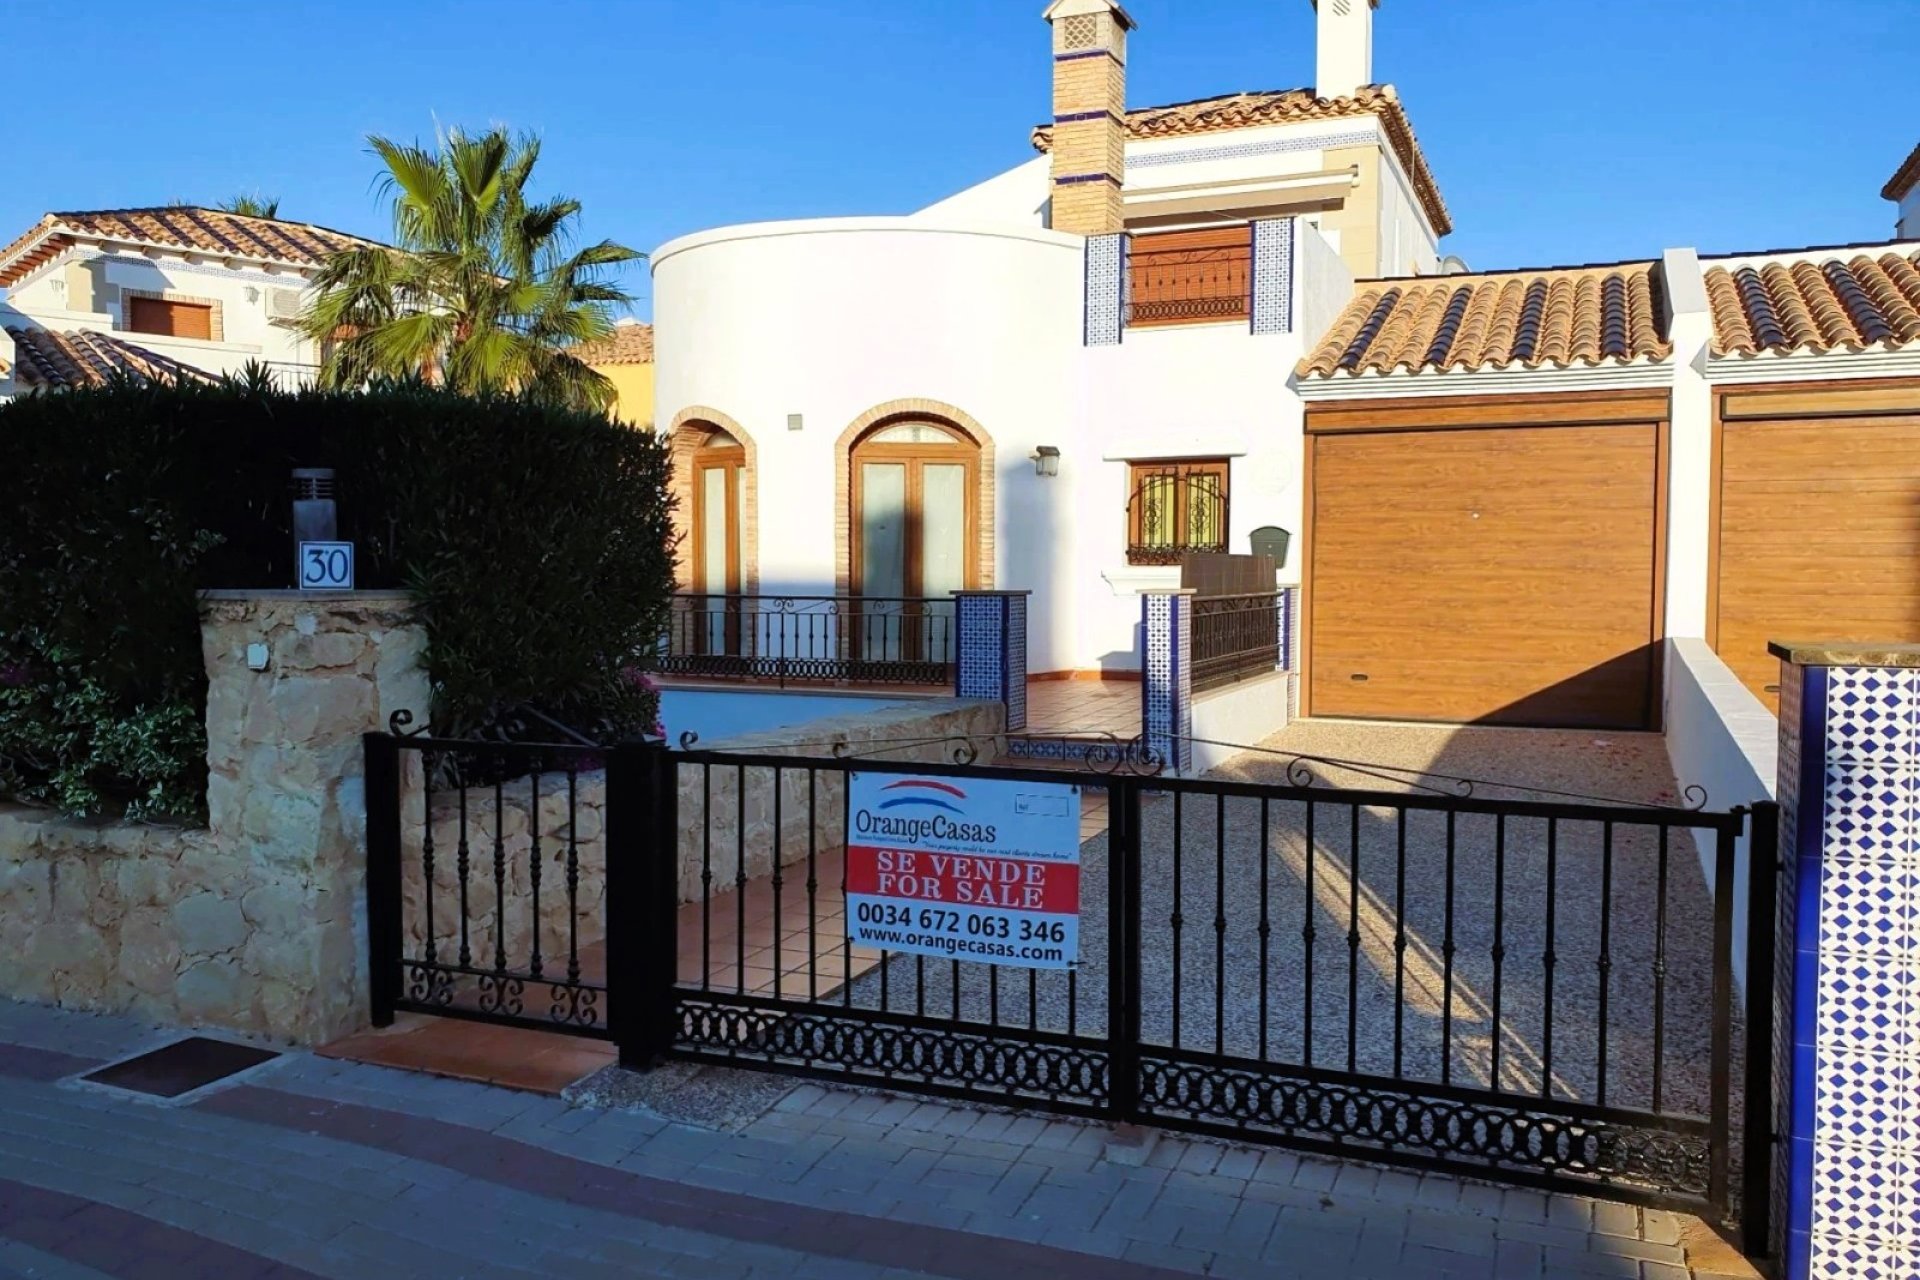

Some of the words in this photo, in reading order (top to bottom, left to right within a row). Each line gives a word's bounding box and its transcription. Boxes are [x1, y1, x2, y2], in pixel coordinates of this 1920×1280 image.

[305, 549, 349, 584] 30
[856, 809, 997, 843] OrangeCasas
[877, 850, 916, 873] SE
[929, 854, 1046, 886] VENDE
[877, 873, 943, 899] FOR
[956, 880, 1044, 909] SALE
[858, 902, 912, 927] 0034
[919, 908, 960, 933] 672
[967, 913, 1010, 939] 063
[1019, 919, 1065, 943] 346
[859, 927, 1063, 961] www.orangecasas.com
